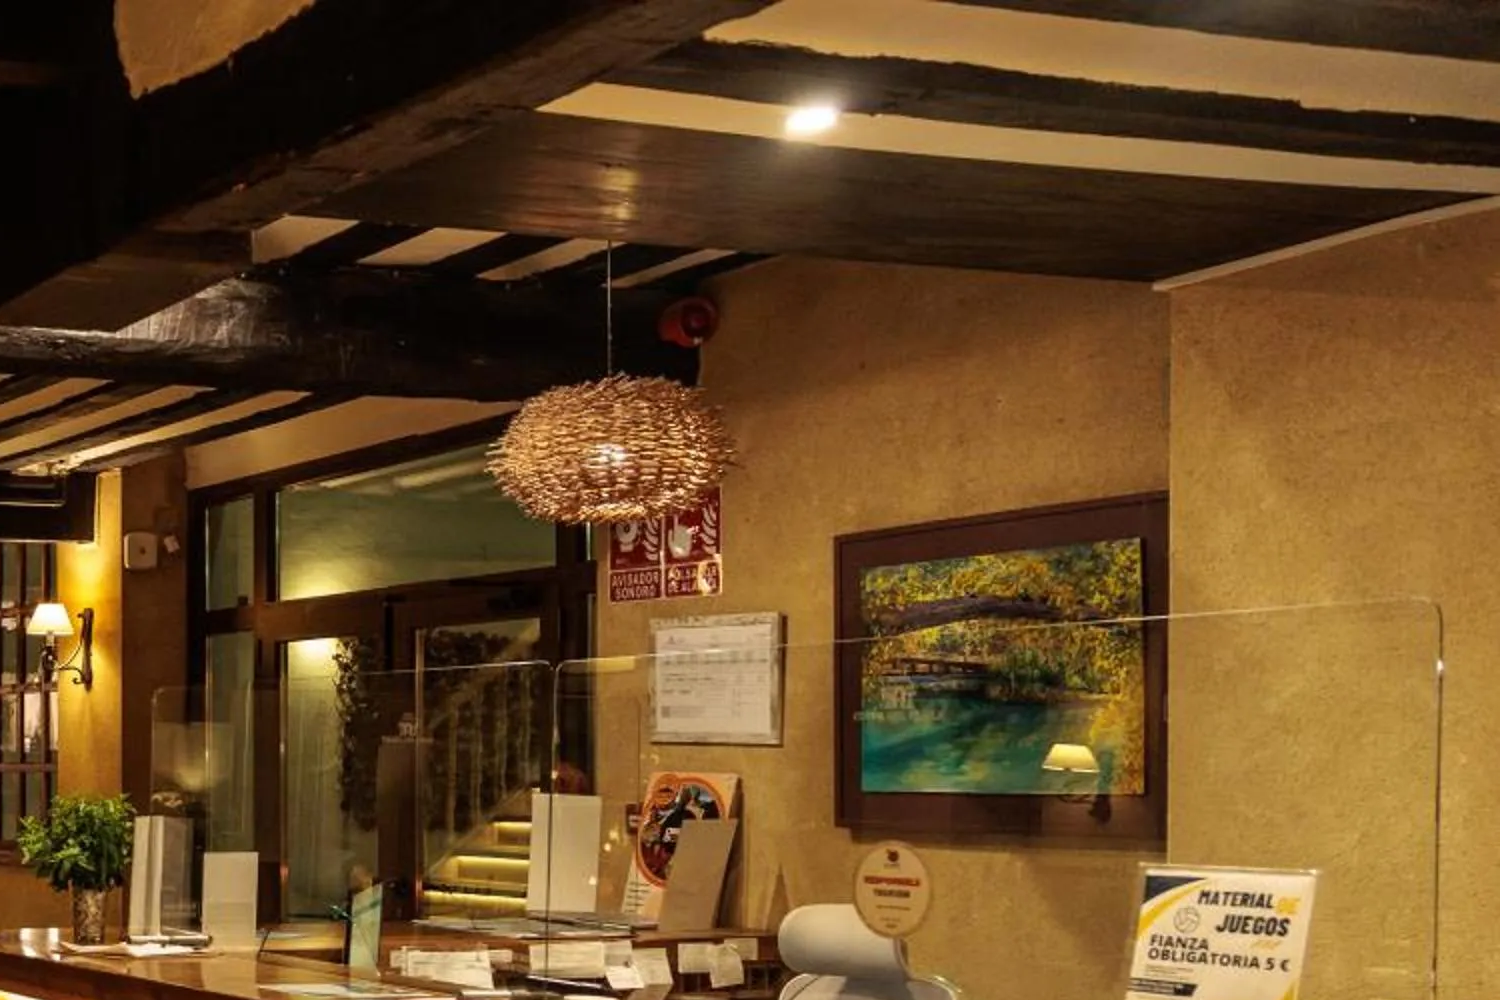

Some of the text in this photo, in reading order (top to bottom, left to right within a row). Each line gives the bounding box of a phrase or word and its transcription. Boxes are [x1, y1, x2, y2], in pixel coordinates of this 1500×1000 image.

[612, 571, 660, 587] AVISADOR
[615, 585, 657, 599] SONORO
[1198, 890, 1274, 909] MATERIAL
[1215, 914, 1291, 937] JUEGOS
[1150, 934, 1209, 950] FIANZA
[1147, 947, 1290, 972] OBLIGATORIA 5 €
